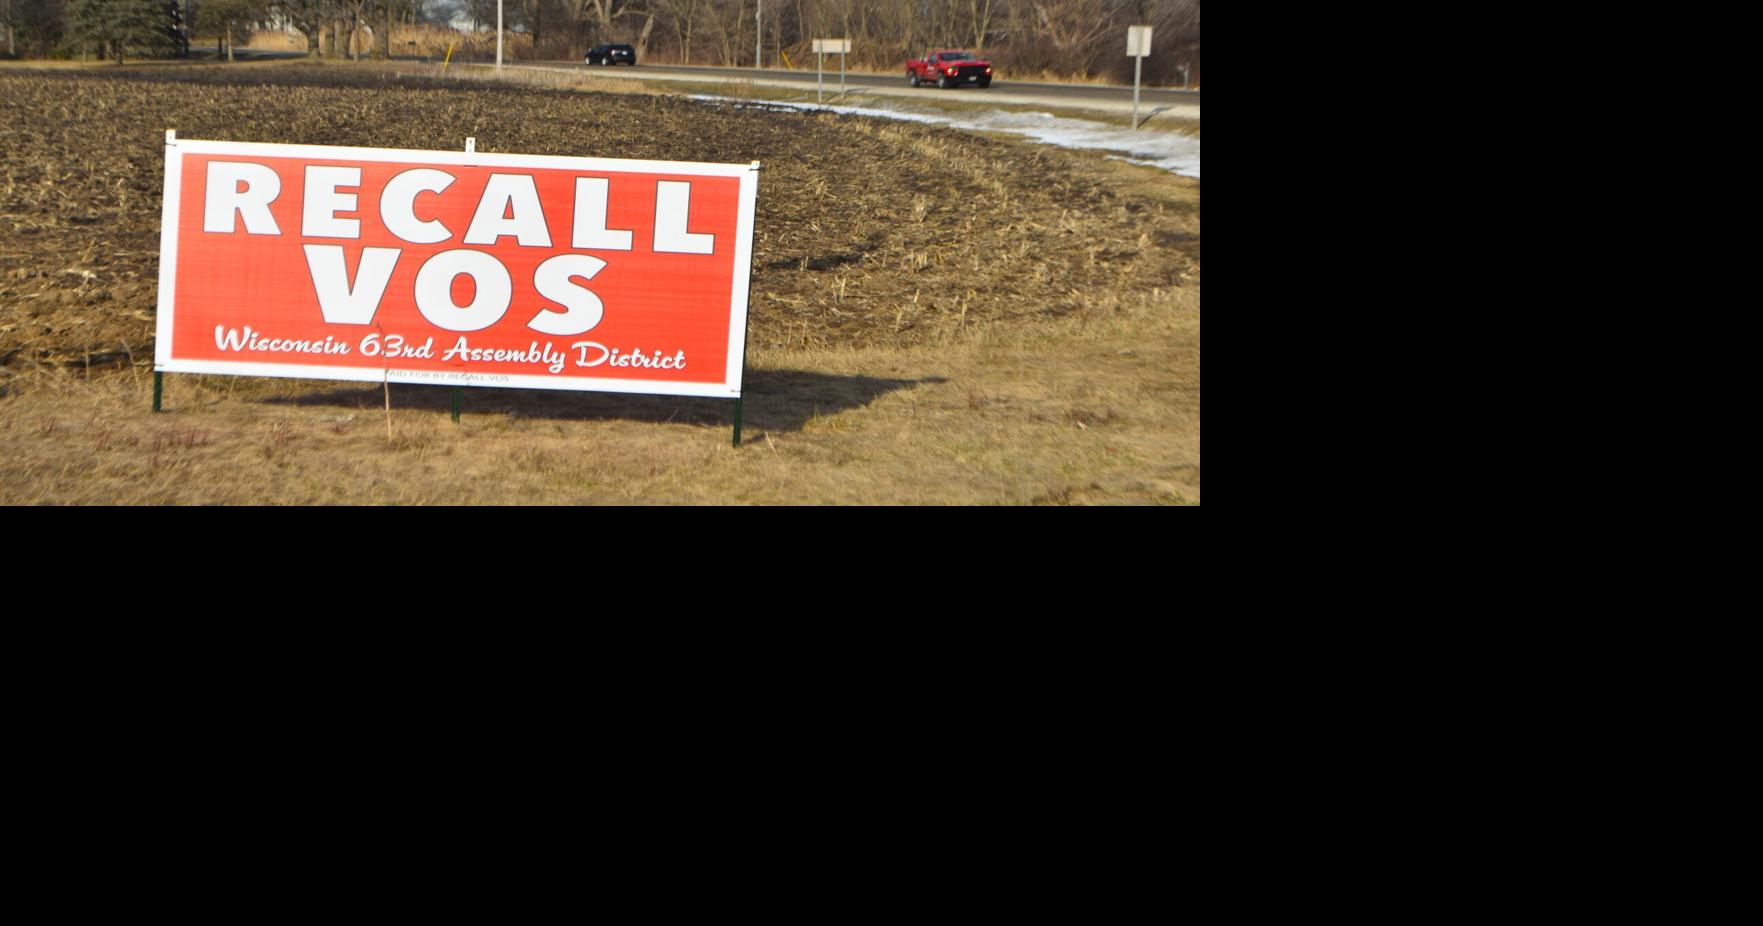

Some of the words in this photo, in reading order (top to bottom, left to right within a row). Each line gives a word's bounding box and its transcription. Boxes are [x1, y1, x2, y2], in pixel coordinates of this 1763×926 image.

[202, 160, 716, 255] RECALL
[302, 243, 609, 336] VOS
[214, 325, 351, 354] Wisconsin
[359, 334, 435, 360] 63rd
[443, 336, 565, 373] Assembly
[572, 341, 687, 371] District
